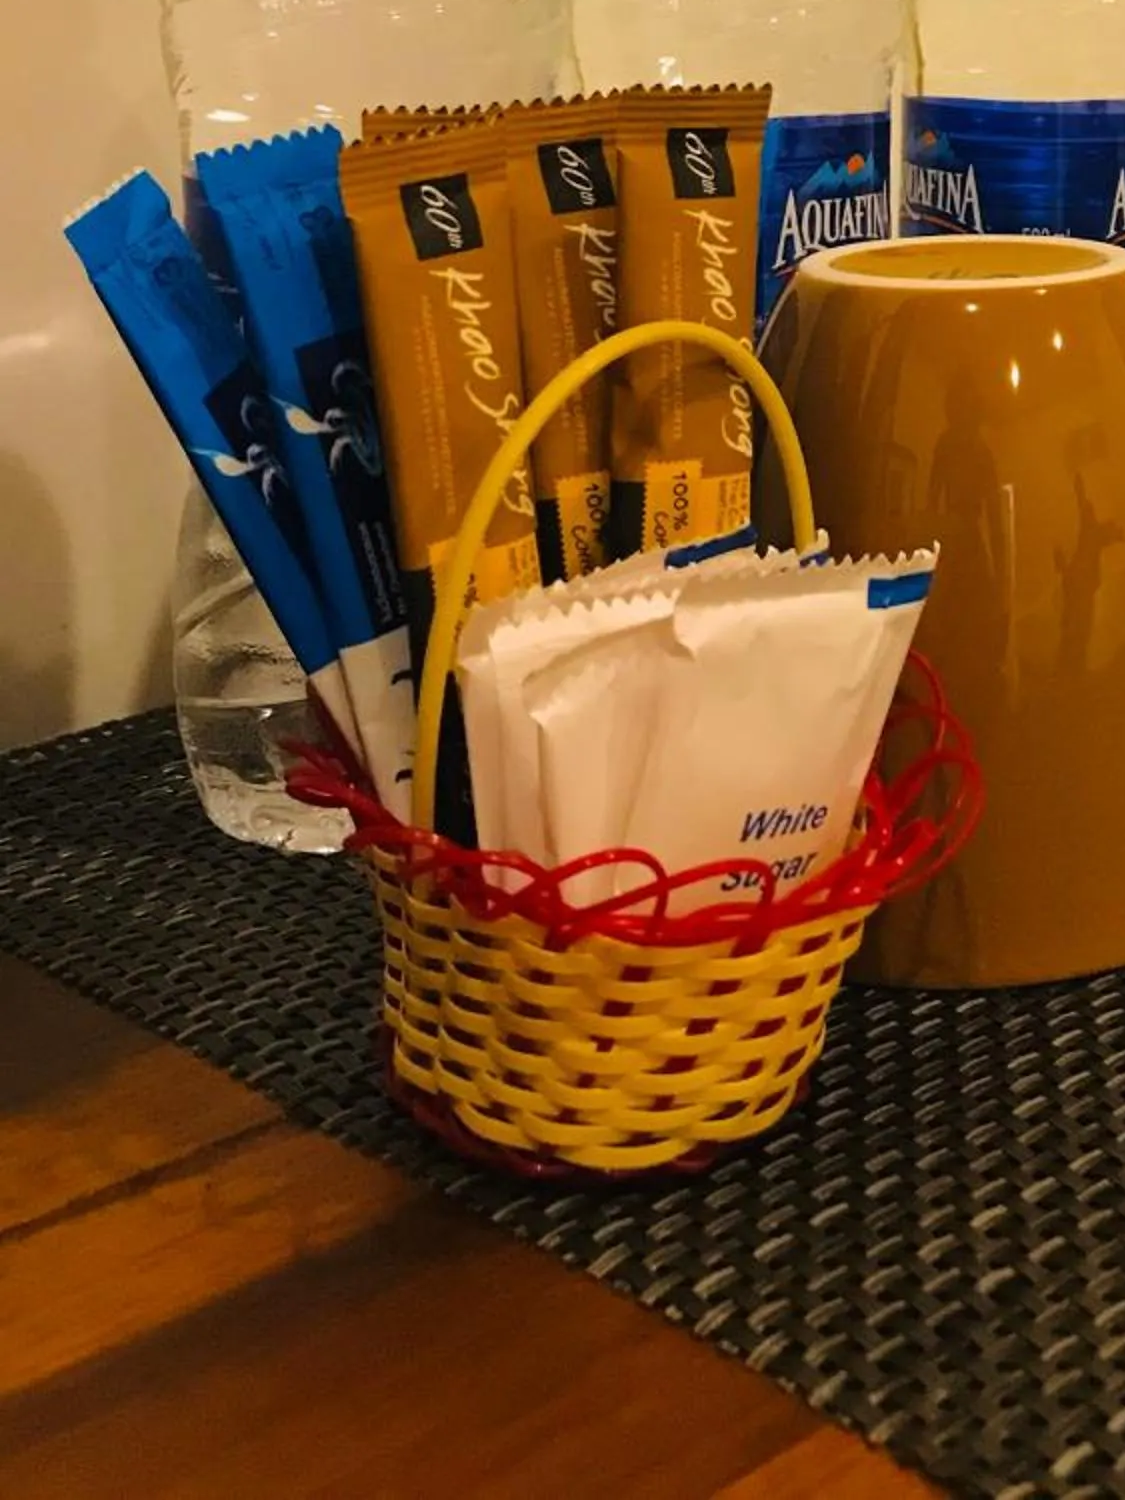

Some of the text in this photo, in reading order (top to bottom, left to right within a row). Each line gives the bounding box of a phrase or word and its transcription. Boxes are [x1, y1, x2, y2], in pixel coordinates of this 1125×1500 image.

[771, 179, 891, 270] AQUAFIN
[672, 470, 689, 532] 100%
[739, 803, 829, 843] White
